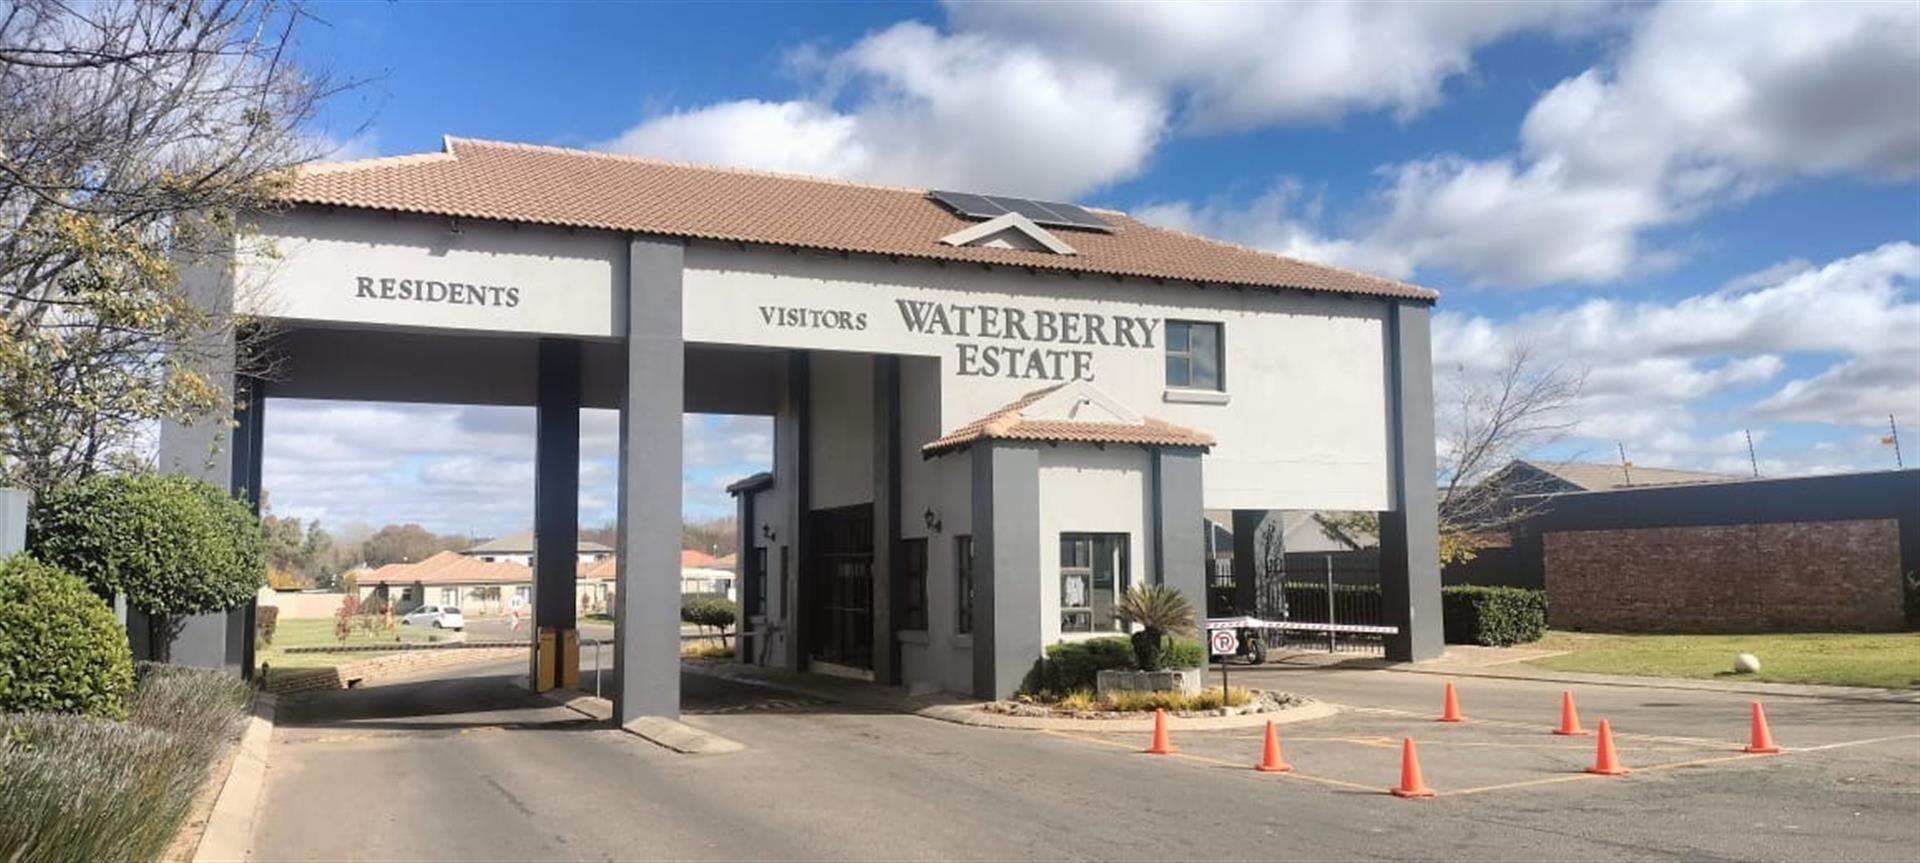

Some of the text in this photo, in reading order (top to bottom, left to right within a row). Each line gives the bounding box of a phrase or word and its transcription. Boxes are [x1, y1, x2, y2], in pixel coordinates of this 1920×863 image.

[355, 276, 520, 307] RESIDENTS
[759, 306, 867, 331] VISITORS
[896, 300, 1160, 348] WATERBERRY
[956, 344, 1095, 382] ESTATE
[1220, 636, 1230, 649] P
